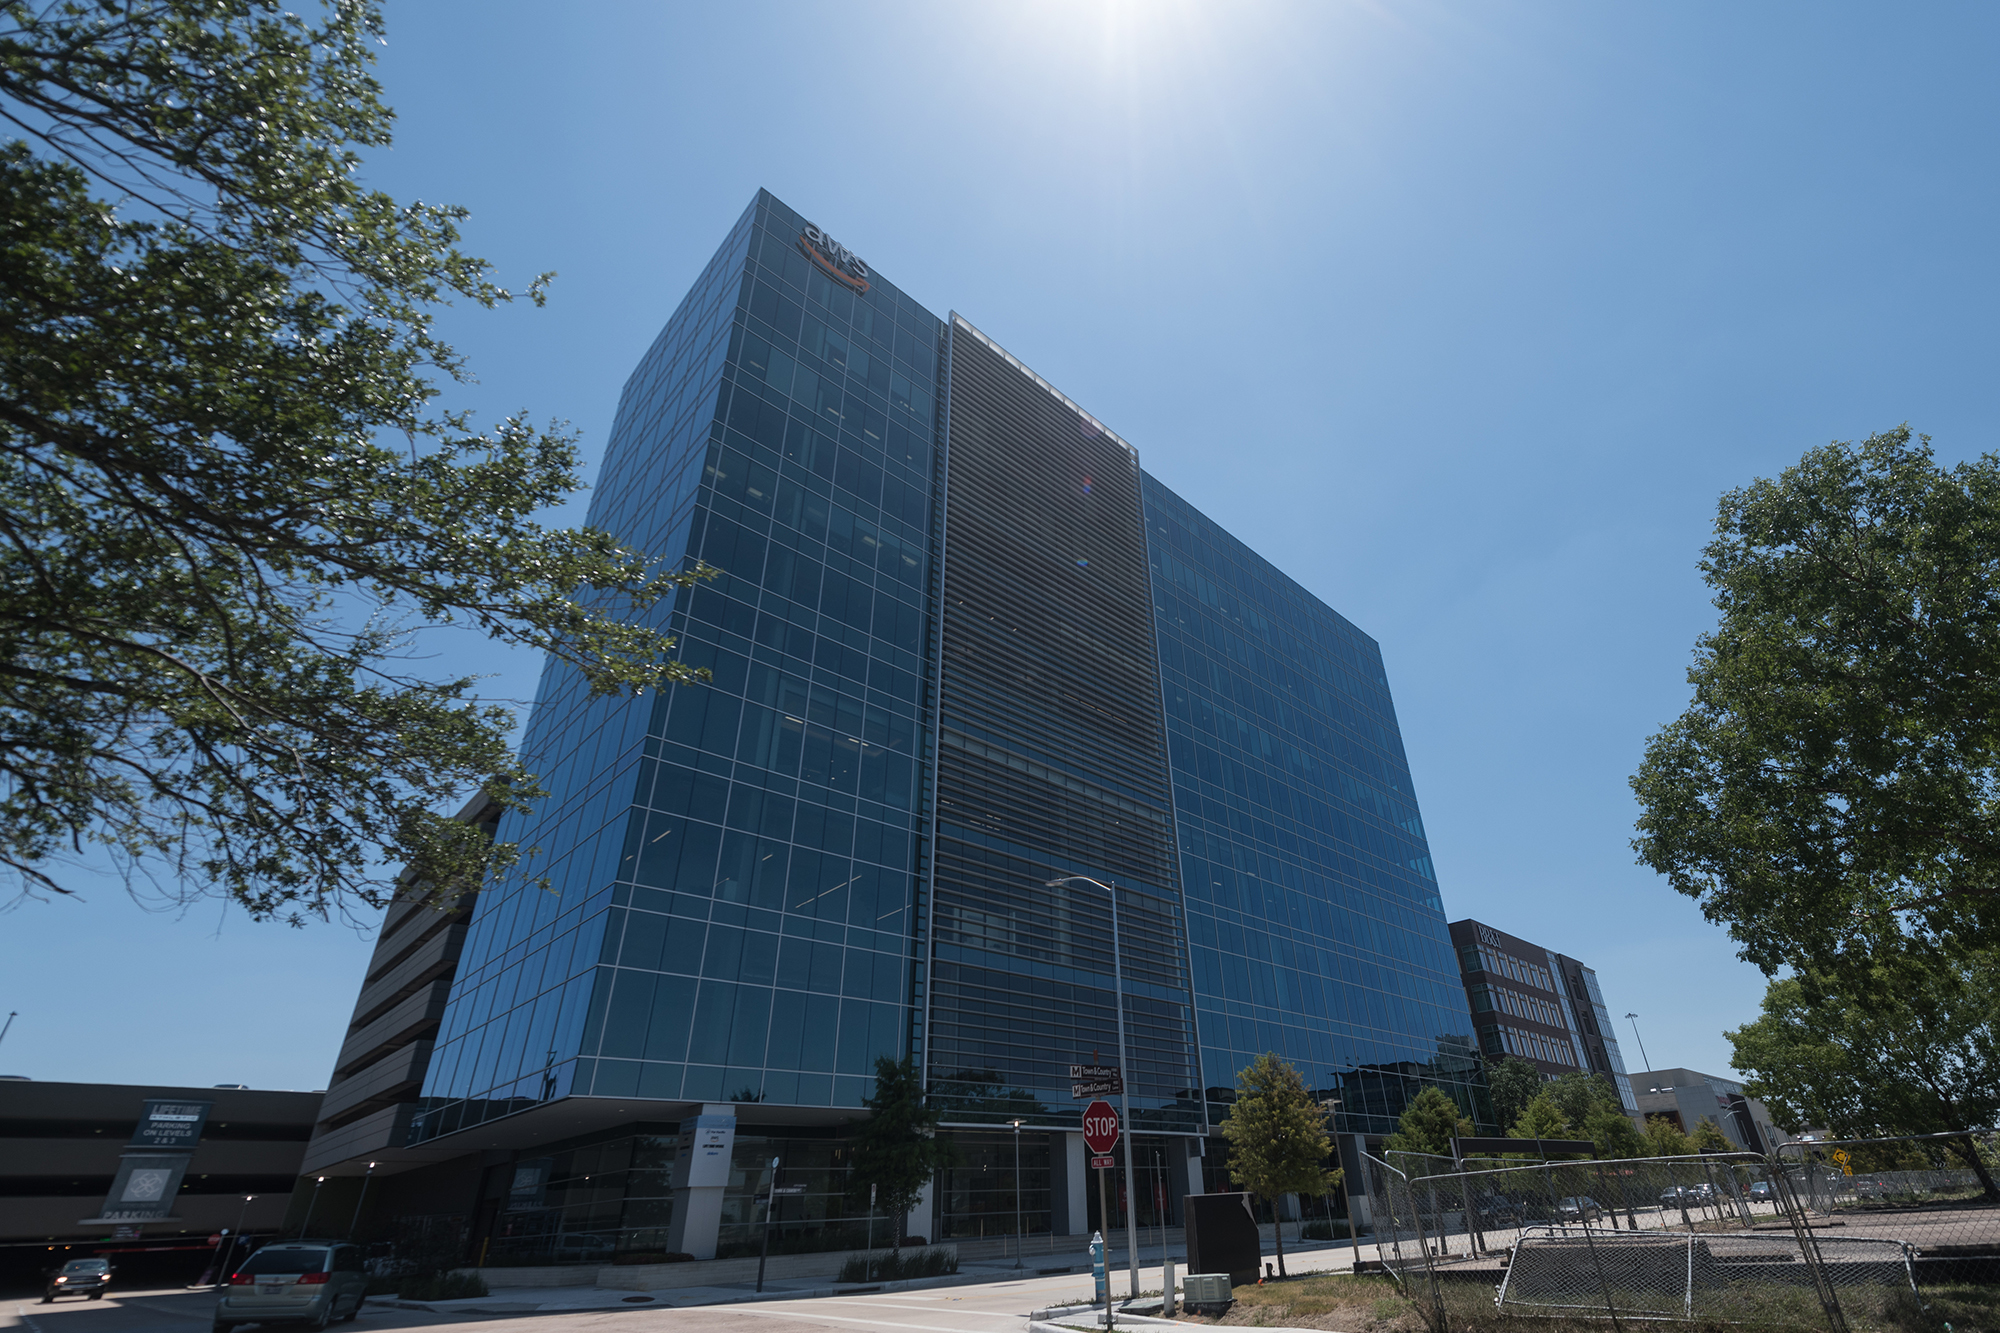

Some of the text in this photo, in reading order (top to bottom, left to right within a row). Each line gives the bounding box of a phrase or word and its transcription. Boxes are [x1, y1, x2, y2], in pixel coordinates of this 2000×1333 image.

[803, 221, 868, 278] aws
[1082, 1066, 1094, 1075] Town
[1097, 1066, 1112, 1078] Country
[1094, 1082, 1111, 1093] Country
[150, 1121, 192, 1129] PARKING
[1086, 1117, 1116, 1137] STOP
[158, 1129, 193, 1137] LEVELS
[102, 1210, 165, 1219] PARKING
